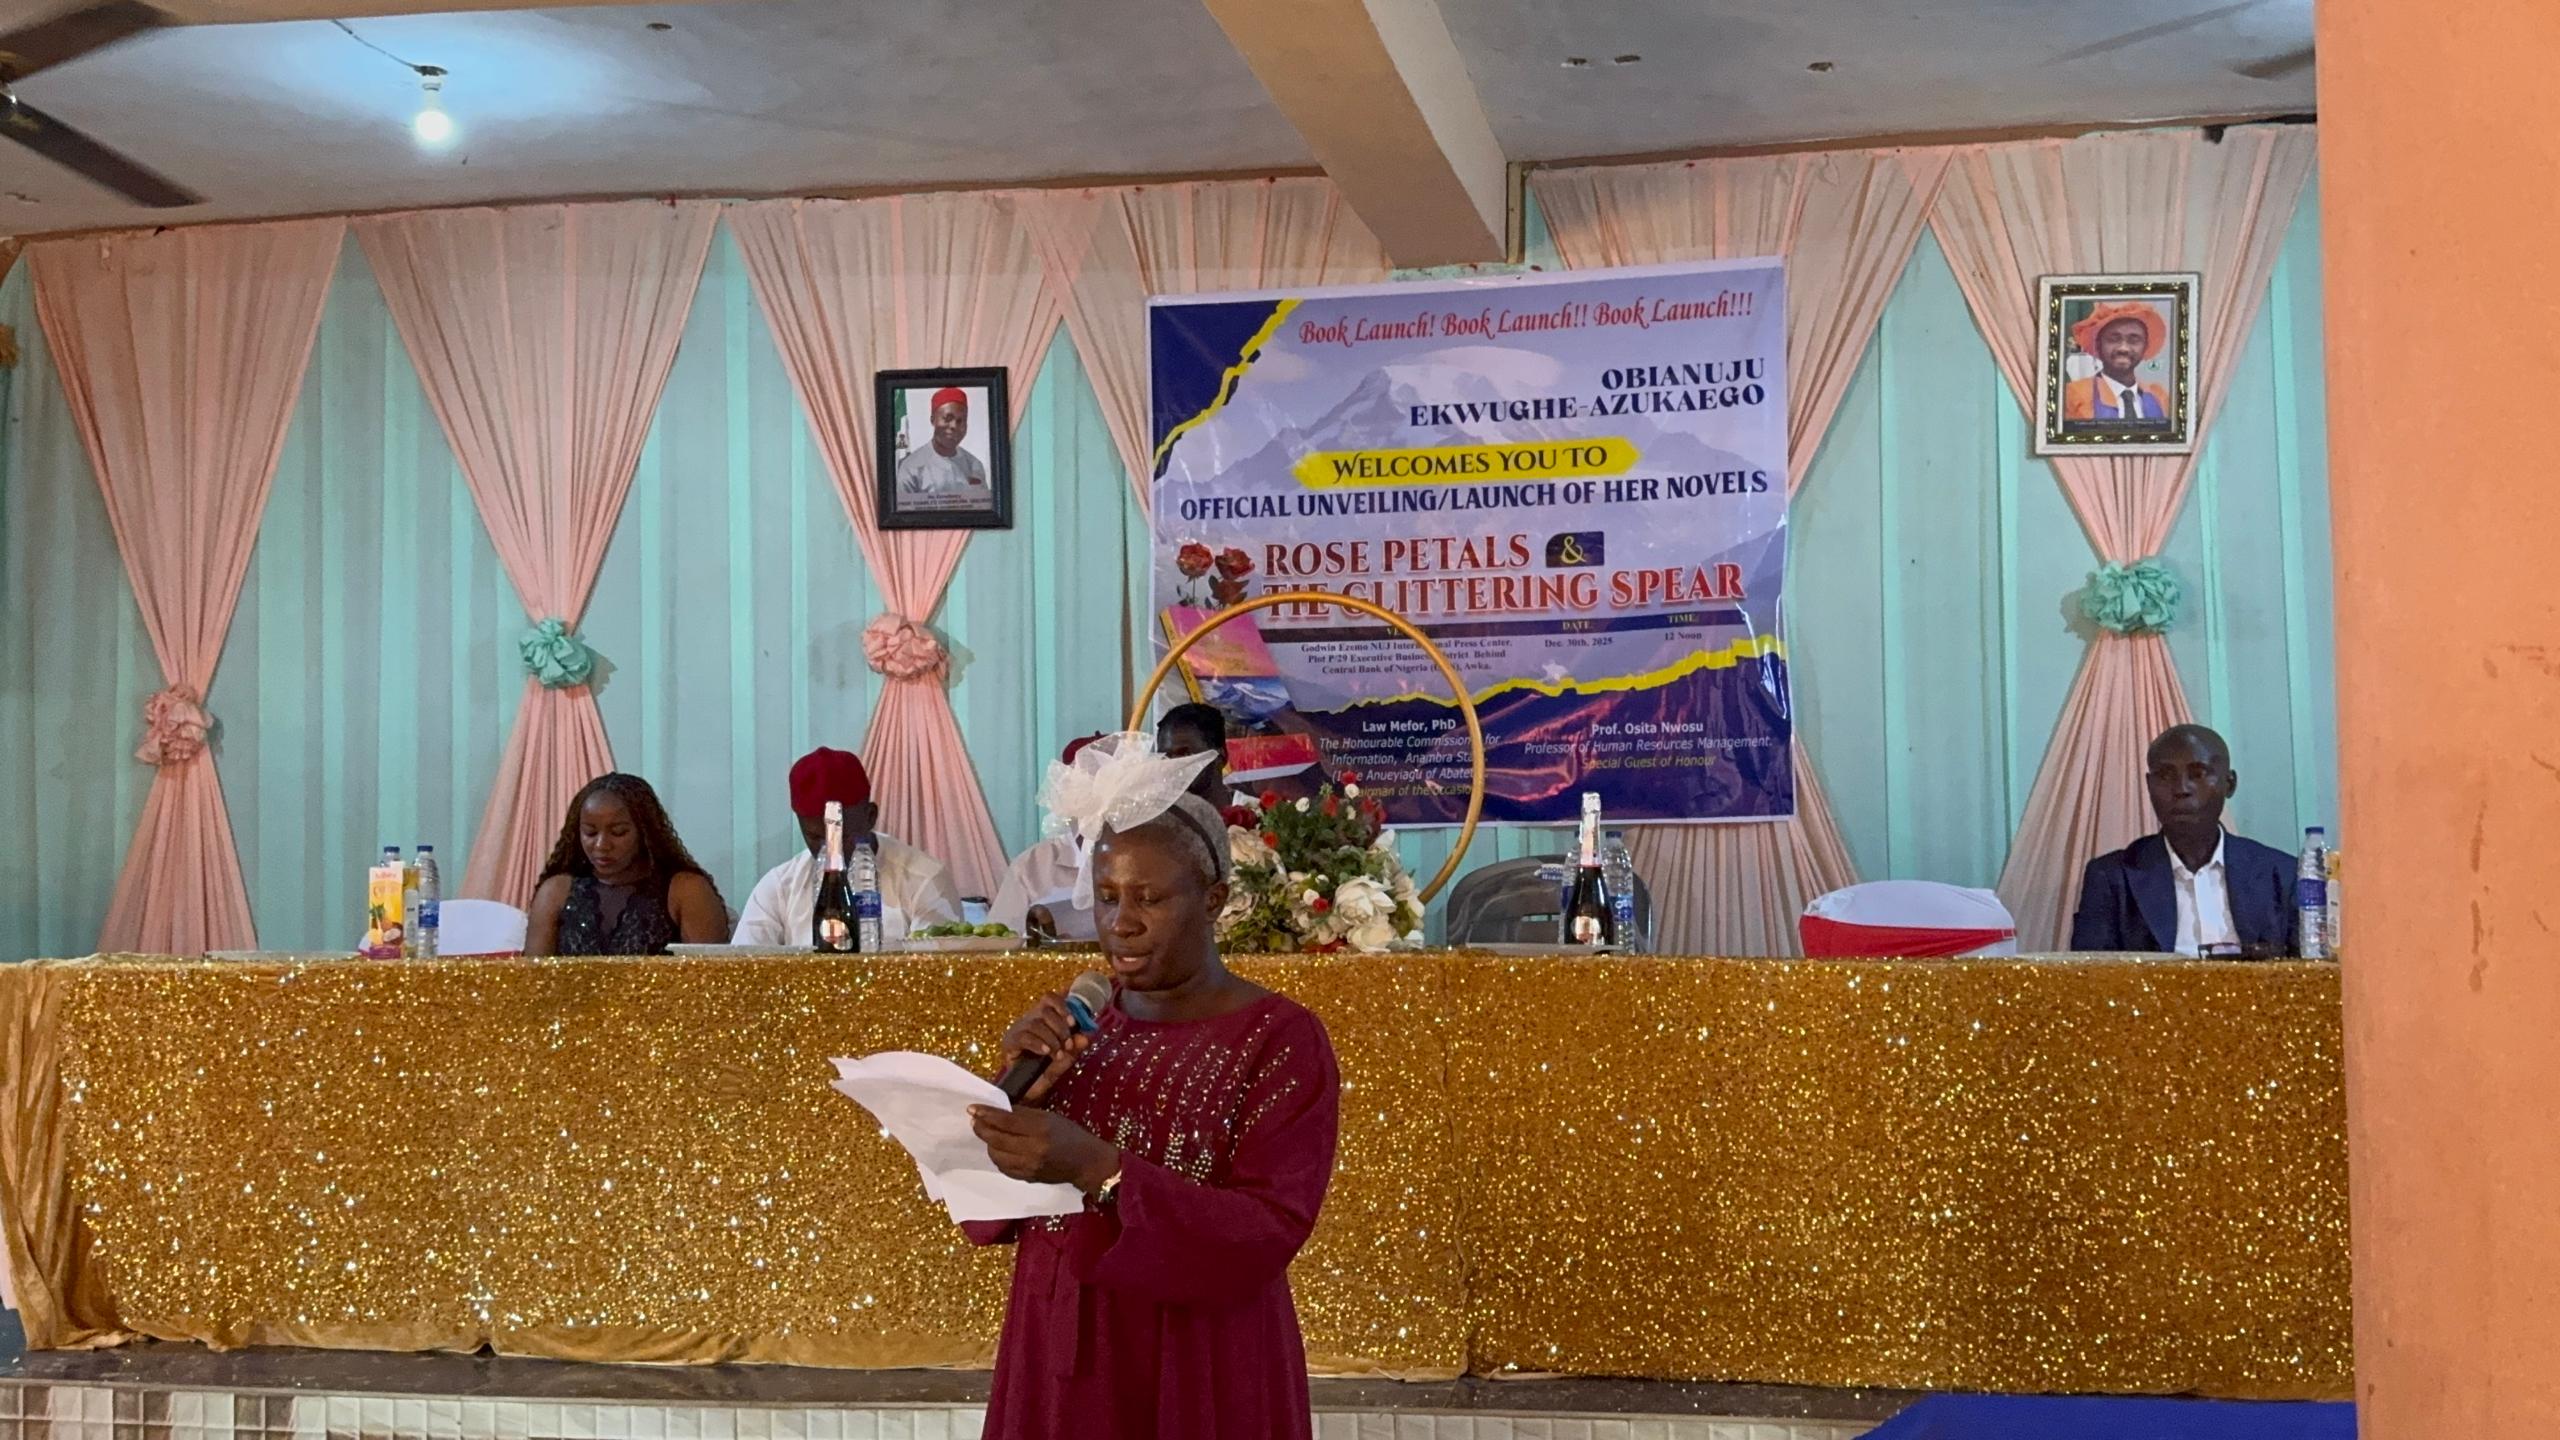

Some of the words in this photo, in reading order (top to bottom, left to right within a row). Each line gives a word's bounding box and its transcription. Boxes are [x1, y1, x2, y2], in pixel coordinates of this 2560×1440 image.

[1299, 316, 1352, 347] Book
[1354, 311, 1436, 342] Launch!
[1441, 308, 1495, 340] Book
[1497, 301, 1587, 334] Launch!!
[1593, 296, 1649, 329] Book
[1650, 289, 1752, 322] Launch!!!
[1602, 357, 1765, 390] OBIANUJU
[1410, 384, 1765, 426] EKWUGHE-AZUKAEGO
[1332, 452, 1489, 484] WELCOMES
[1496, 449, 1557, 471] YOU
[1563, 446, 1607, 468] TO
[1181, 495, 1291, 520] OFFICIAL
[1298, 483, 1555, 516] UNVEILING/LAUNCH
[1563, 481, 1596, 505] OF
[1604, 478, 1659, 503] HER
[1667, 470, 1768, 499] NOVELS
[1265, 541, 1370, 576] ROSE
[1383, 534, 1530, 573] PETALS
[1561, 536, 1587, 564] &
[1342, 572, 1599, 616] GLITTERING
[1611, 563, 1746, 605] SPEAR
[1667, 613, 1695, 624] TIME
[1562, 621, 1589, 632] DATE
[1592, 636, 1613, 646] 2025
[1665, 632, 1675, 641] 12
[1678, 631, 1702, 640] Noon
[1301, 643, 1336, 652] Godwin
[1454, 640, 1478, 648] Press
[1308, 655, 1325, 663] Plot
[1351, 653, 1393, 662] Executive
[1474, 650, 1506, 658] Behind
[1322, 665, 1356, 674] Central
[1359, 664, 1382, 673] Bank
[1384, 664, 1393, 673] of
[1396, 664, 1428, 674] Nigeria
[1362, 721, 1387, 732] Law
[1390, 719, 1428, 733] Mefor,
[1432, 719, 1457, 730] PhD
[1592, 723, 1621, 735] Prof.
[1624, 722, 1657, 734] Osita
[1661, 721, 1704, 733] Nwosu
[1320, 738, 1339, 749] The
[1342, 735, 1404, 749] Honourable
[1484, 732, 1500, 745] for
[1524, 741, 1576, 754] Professor
[1579, 740, 1591, 752] of
[1593, 740, 1633, 752] Human
[1636, 738, 1694, 751] Resources
[1697, 736, 1773, 750] Management.
[1331, 753, 1398, 766] Information,
[1405, 751, 1453, 764] Anambra
[1582, 757, 1621, 770] Special
[1624, 756, 1657, 768] Guest
[1660, 755, 1673, 767] of
[1675, 754, 1717, 766] Honour
[1425, 768, 1438, 779] of
[1398, 785, 1410, 796] of
[1412, 784, 1430, 795] the
